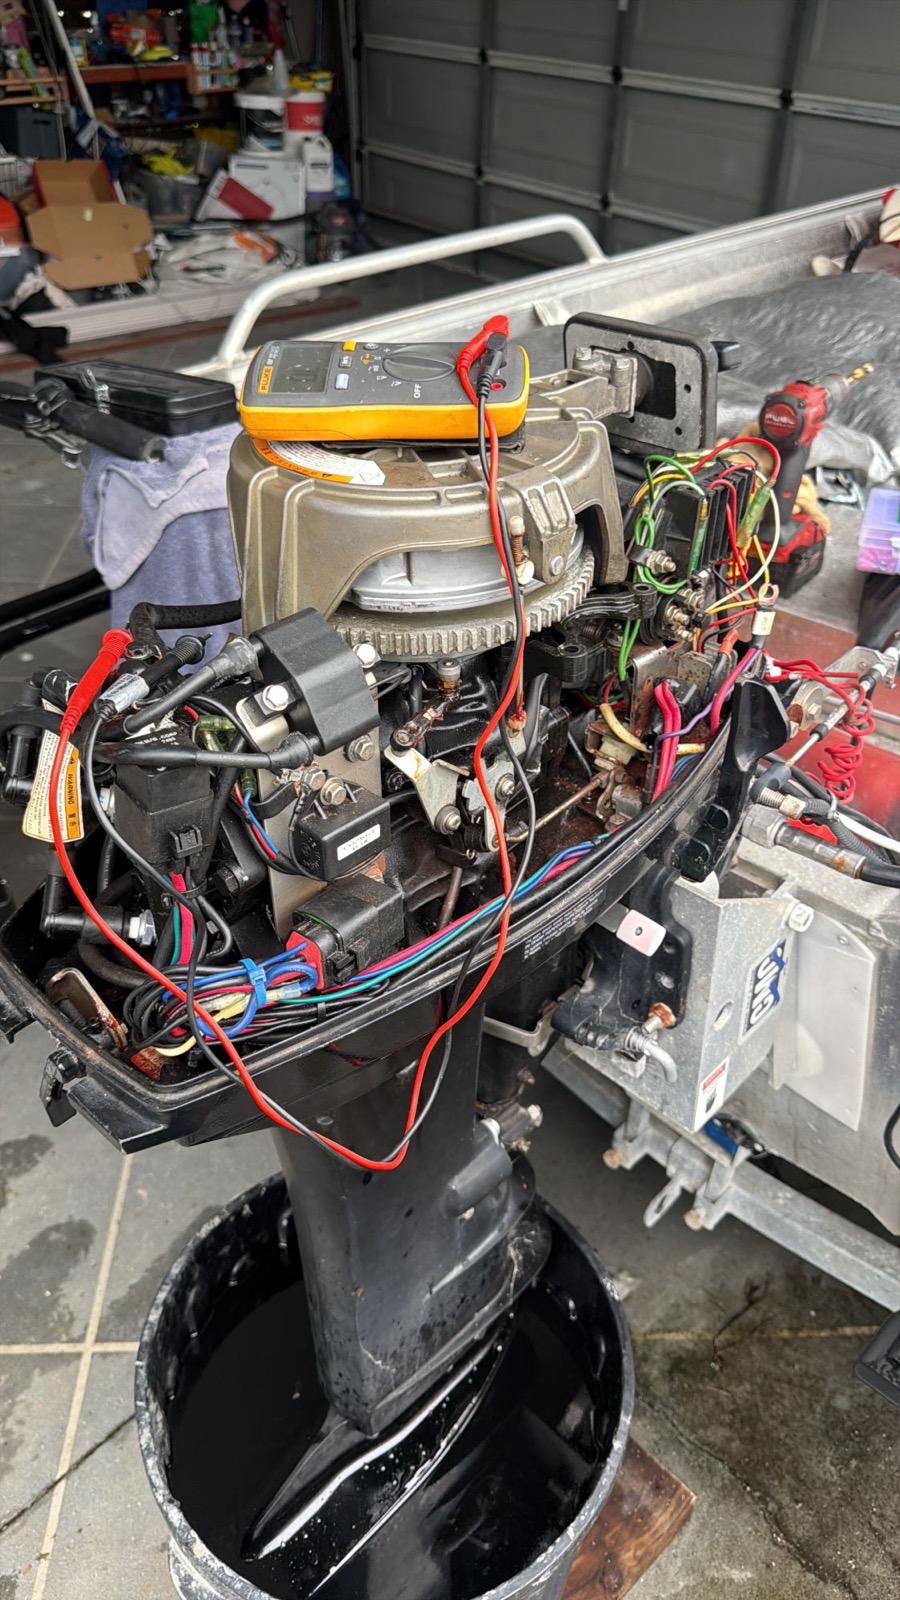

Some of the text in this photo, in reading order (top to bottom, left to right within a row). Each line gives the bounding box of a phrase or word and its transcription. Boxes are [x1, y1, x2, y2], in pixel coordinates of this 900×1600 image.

[261, 369, 272, 391] FLUKE
[413, 384, 422, 398] OFF
[67, 773, 76, 805] WARNING
[749, 947, 783, 1025] CMC
